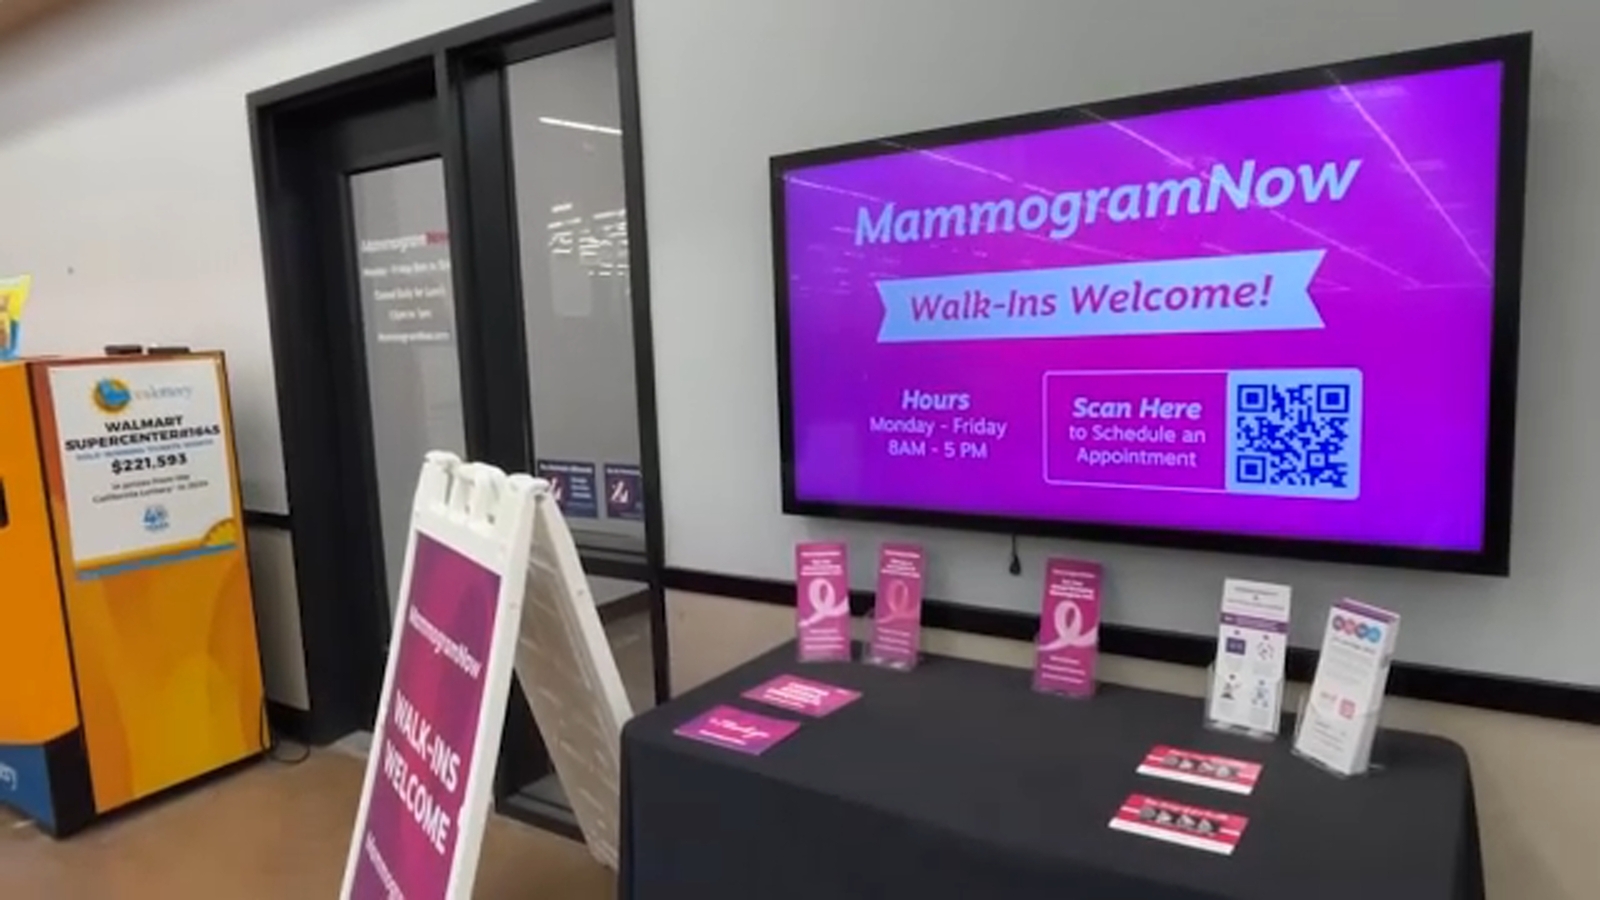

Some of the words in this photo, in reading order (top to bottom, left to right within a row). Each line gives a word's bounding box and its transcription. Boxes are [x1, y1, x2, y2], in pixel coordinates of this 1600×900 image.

[854, 158, 1362, 247] MammogramNow
[909, 289, 1057, 323] Walk-Ins
[1070, 274, 1274, 315] Welcome!
[901, 389, 971, 411] Hours
[1072, 397, 1132, 419] Scan
[1139, 397, 1202, 420] Here
[104, 415, 183, 433] WALMART
[869, 416, 935, 438] Monday
[953, 417, 1008, 440] Friday
[1069, 425, 1088, 441] to
[1091, 424, 1177, 443] Schedule
[1181, 429, 1207, 444] an
[887, 439, 927, 457] 8AM
[943, 441, 956, 458] 5
[960, 441, 988, 459] PM
[1076, 446, 1198, 468] Appointment
[111, 453, 187, 475] $221,593
[394, 690, 461, 793] WALK-INS
[383, 738, 450, 856] WELCOME
